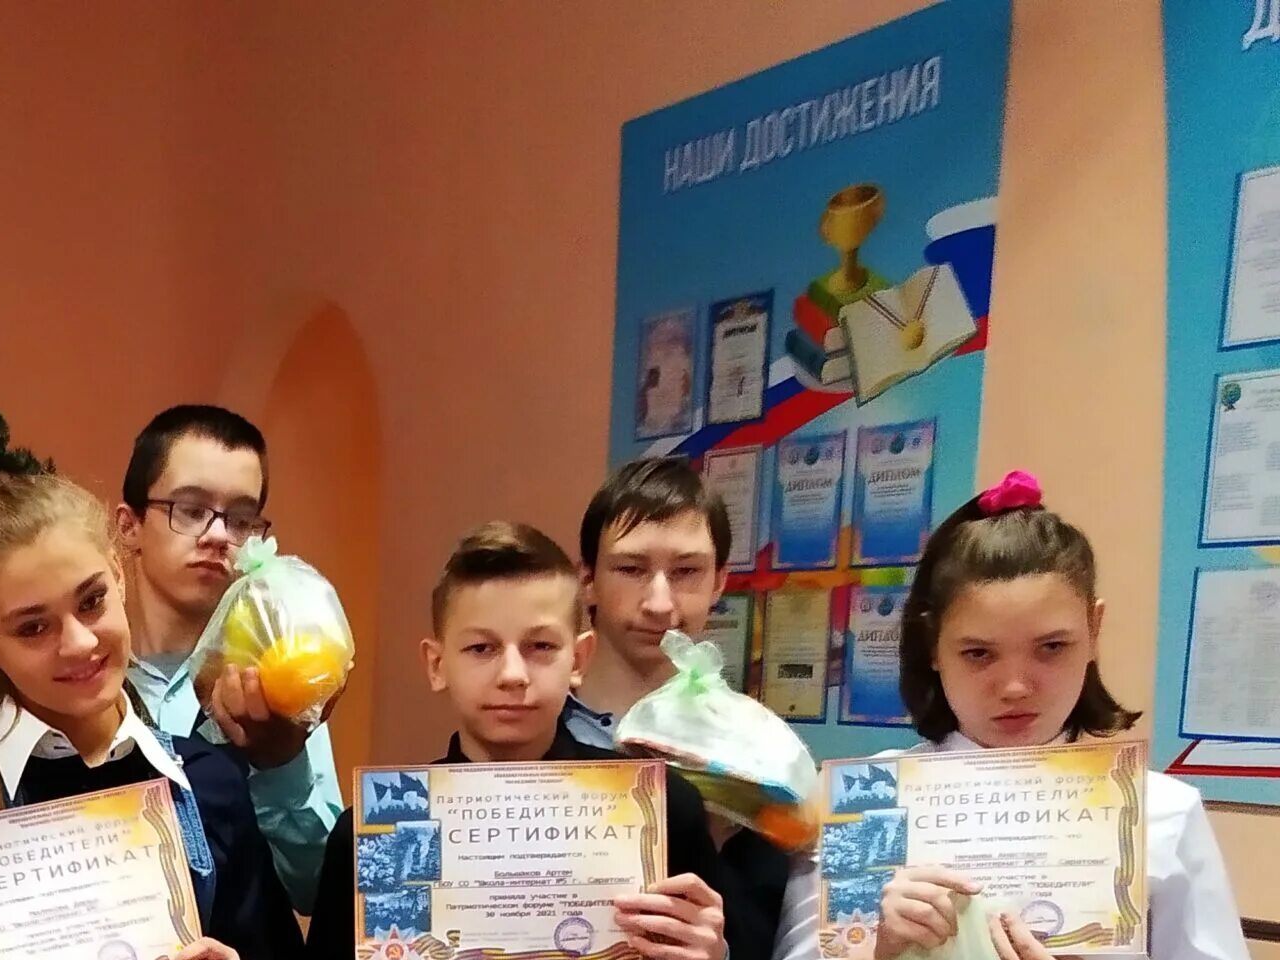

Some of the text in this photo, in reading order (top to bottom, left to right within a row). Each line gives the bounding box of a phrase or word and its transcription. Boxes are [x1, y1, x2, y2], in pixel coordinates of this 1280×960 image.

[663, 55, 941, 194] НАШИ ДОСТИЖЕНИЯ
[436, 790, 628, 805] Патриотический форум
[915, 806, 1115, 830] СЕРТИФИКАТ
[448, 824, 636, 845] СЕРТИФИКАТ
